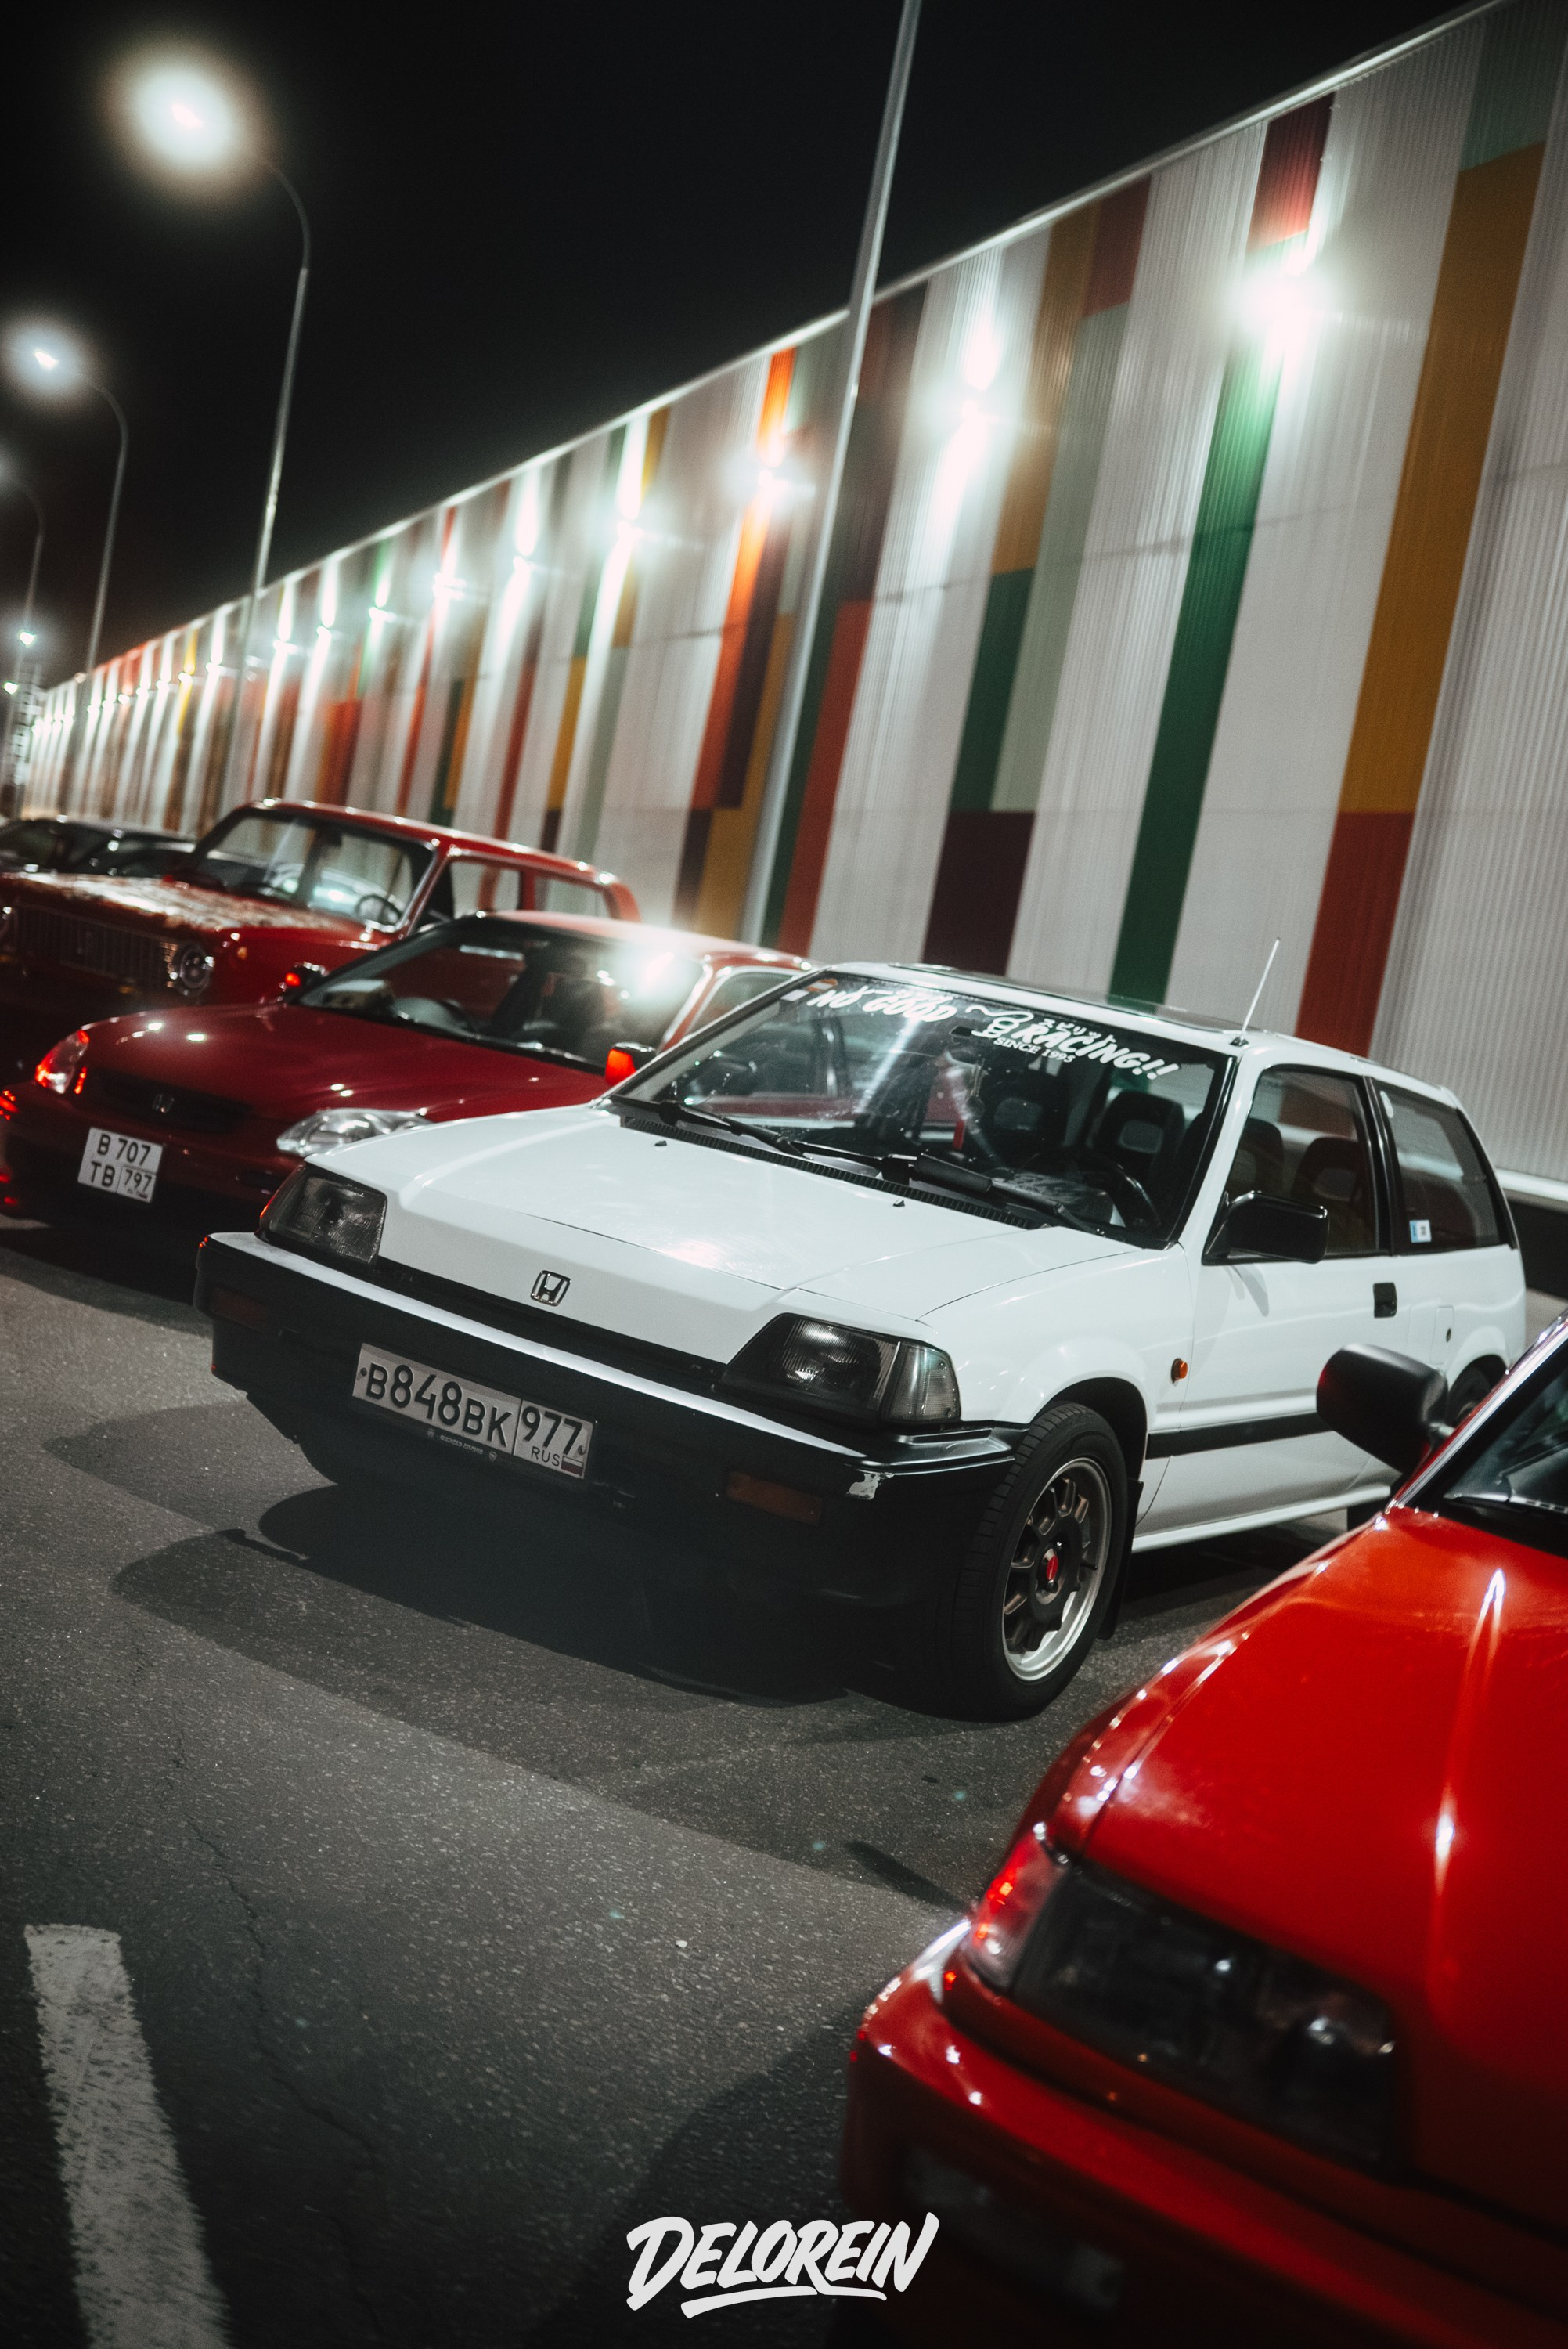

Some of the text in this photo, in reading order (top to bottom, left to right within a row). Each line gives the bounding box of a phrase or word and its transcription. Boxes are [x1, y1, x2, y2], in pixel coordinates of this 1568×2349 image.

[806, 989, 1179, 1080] NO GOOD RACING!!
[993, 1037, 1076, 1063] SINCE 1995
[116, 1138, 151, 1166] 707
[124, 1168, 152, 1192] 797
[521, 1405, 583, 1455] 977
[530, 1446, 561, 1467] RUS
